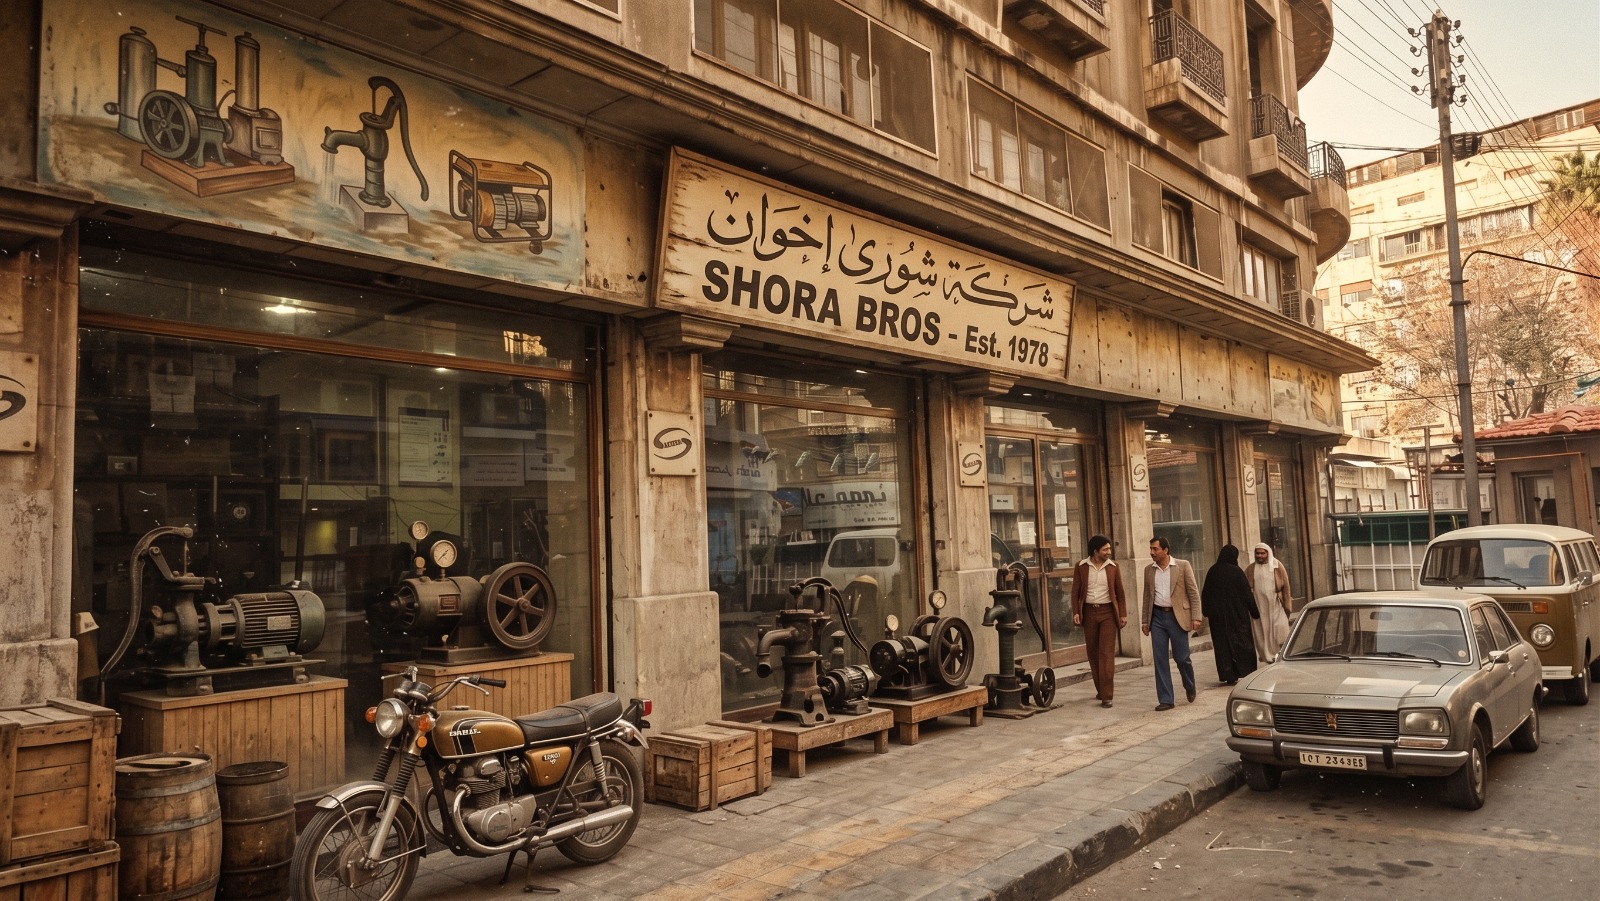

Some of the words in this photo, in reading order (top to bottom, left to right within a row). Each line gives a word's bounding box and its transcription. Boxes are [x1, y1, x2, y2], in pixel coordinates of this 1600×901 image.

[702, 260, 842, 326] SHORA
[856, 295, 941, 346] BROS
[965, 325, 1001, 358] Est.
[1009, 335, 1049, 367] 1978
